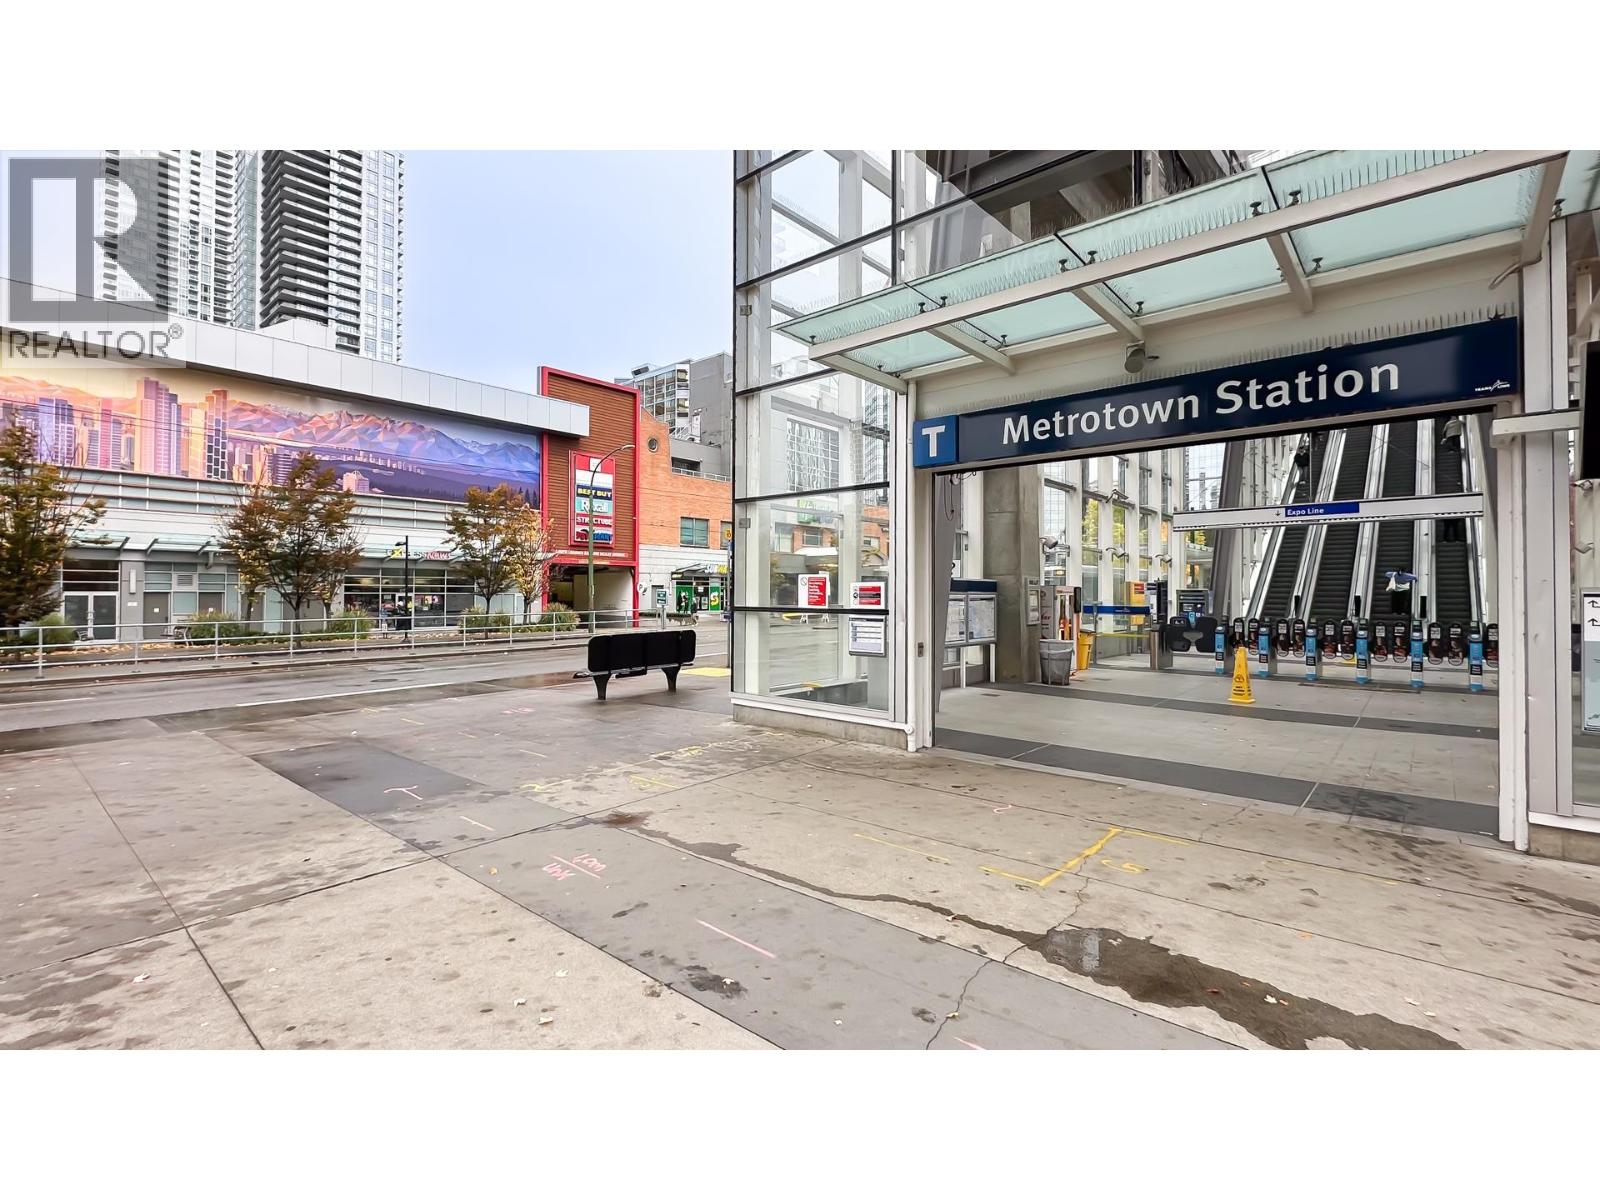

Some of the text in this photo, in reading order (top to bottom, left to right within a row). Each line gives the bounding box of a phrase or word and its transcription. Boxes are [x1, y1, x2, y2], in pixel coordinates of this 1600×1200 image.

[922, 363, 1398, 457] T Metrotown Station
